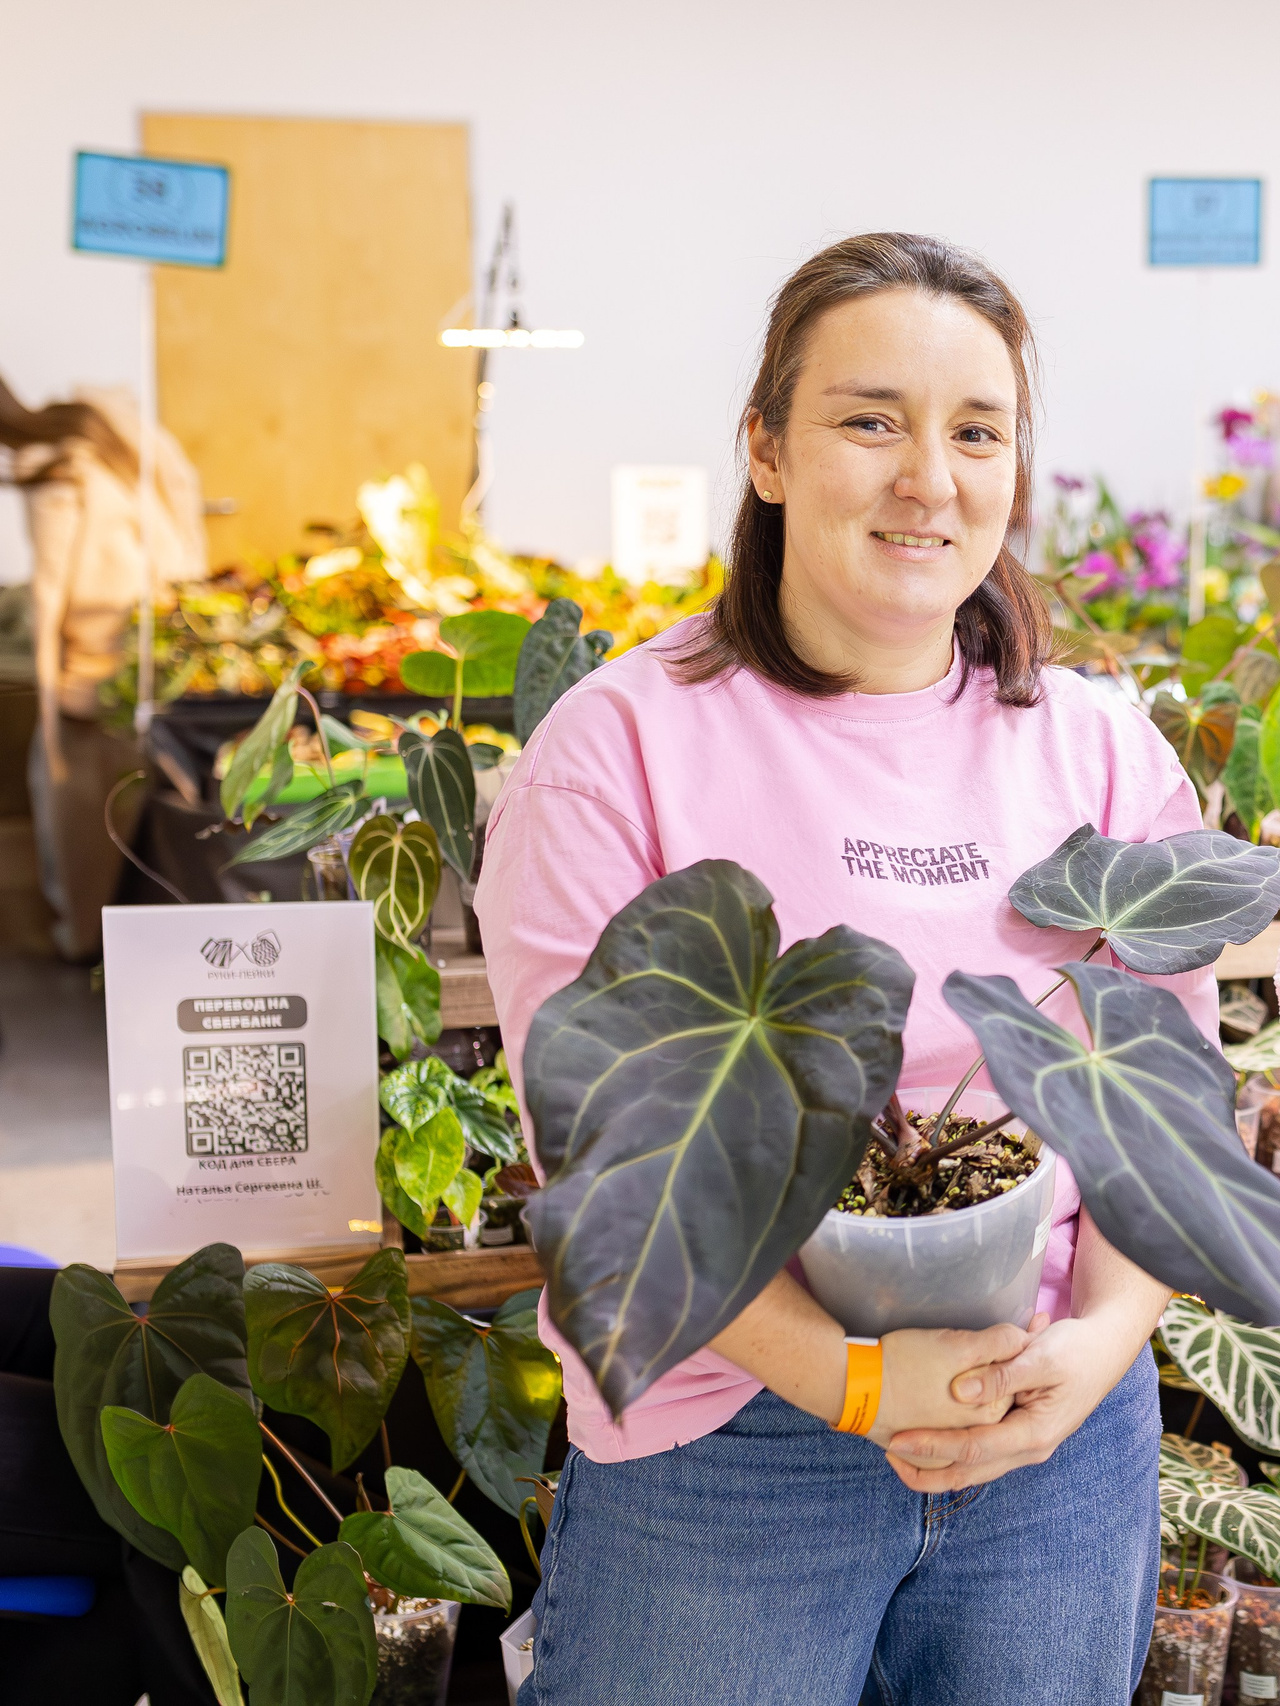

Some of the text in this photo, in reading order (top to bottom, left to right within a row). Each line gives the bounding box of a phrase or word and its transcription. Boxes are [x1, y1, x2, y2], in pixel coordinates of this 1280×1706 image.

[843, 836, 982, 868] APPRECIATE
[841, 855, 990, 886] THE MOMENT
[193, 997, 290, 1013] ПЕРЕВОД НА
[201, 1014, 282, 1030] СБЕРБАНК
[199, 1159, 227, 1171] КОД
[257, 1156, 297, 1168] СБЕРА
[176, 1185, 232, 1197] Наталья
[234, 1181, 302, 1195] Сергеевна
